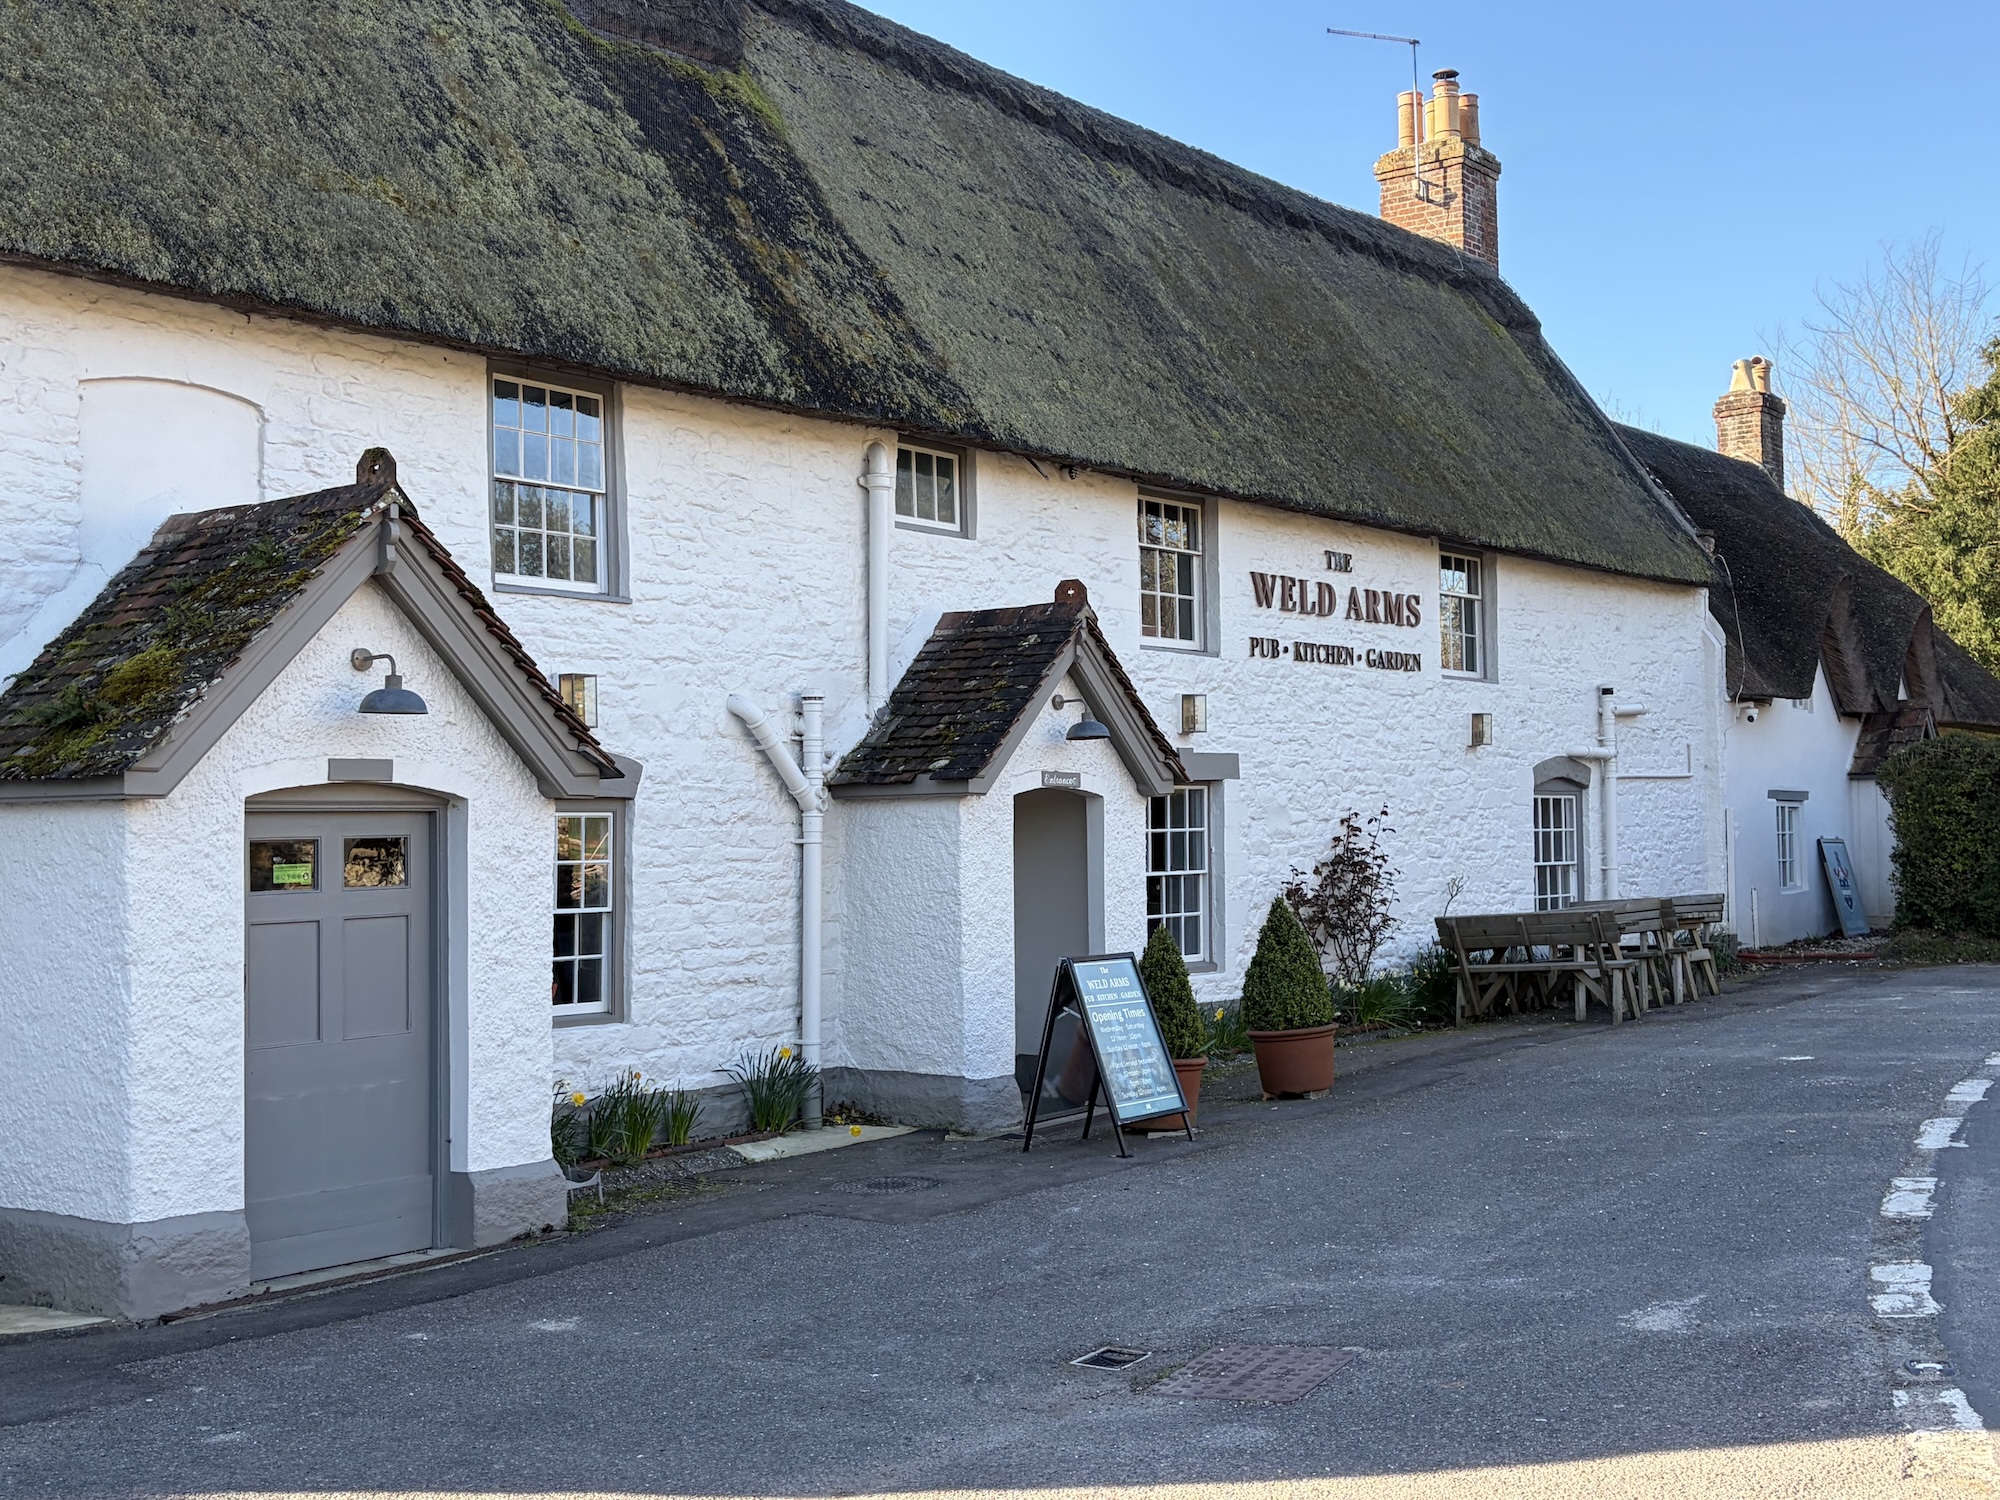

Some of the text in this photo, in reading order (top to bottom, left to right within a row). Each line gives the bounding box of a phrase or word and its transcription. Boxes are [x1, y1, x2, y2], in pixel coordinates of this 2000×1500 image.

[1324, 550, 1352, 572] THE
[1250, 571, 1421, 627] WELD ARMS
[1249, 637, 1421, 671] PUB KITCHEN GARDEN
[1087, 977, 1130, 989] WELD ARMS
[1097, 993, 1118, 1001] KITCHEN
[1121, 991, 1141, 999] GARDEN
[1092, 1008, 1145, 1024] Opening Times
[1100, 1025, 1124, 1033] Wednesday
